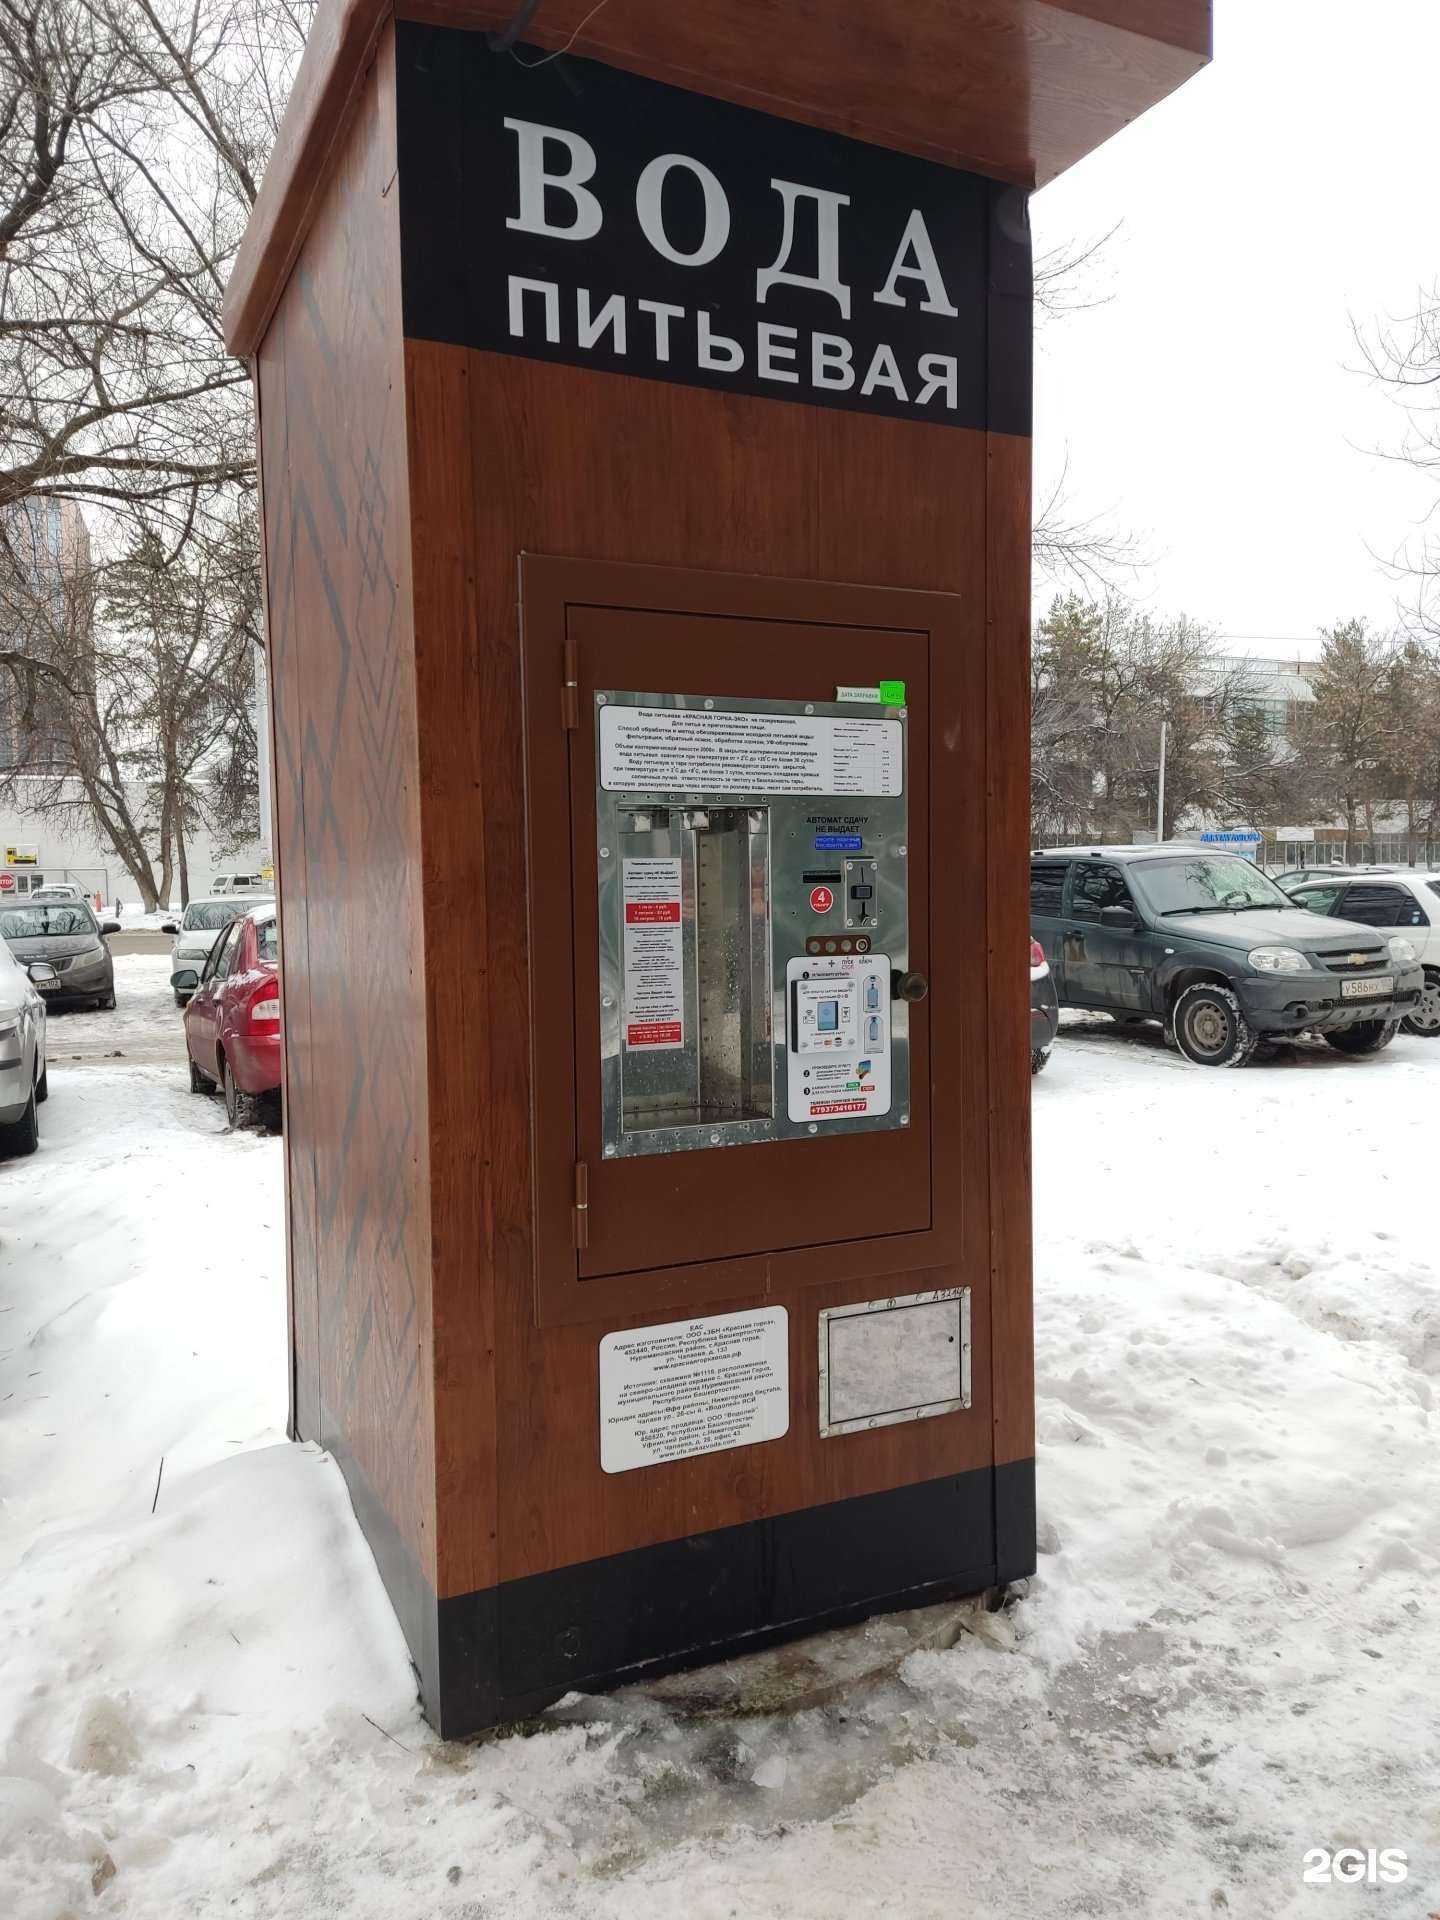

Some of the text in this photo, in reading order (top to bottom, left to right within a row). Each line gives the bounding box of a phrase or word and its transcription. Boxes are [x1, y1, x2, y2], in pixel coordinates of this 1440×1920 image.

[504, 117, 958, 320] ВОДА
[508, 275, 957, 408] ПИТЬЕВАЯ
[807, 816, 869, 825] АВТОМАТ СДАЧУ
[815, 825, 860, 834] НЕ ВЫДАЕТ
[817, 890, 826, 902] 4
